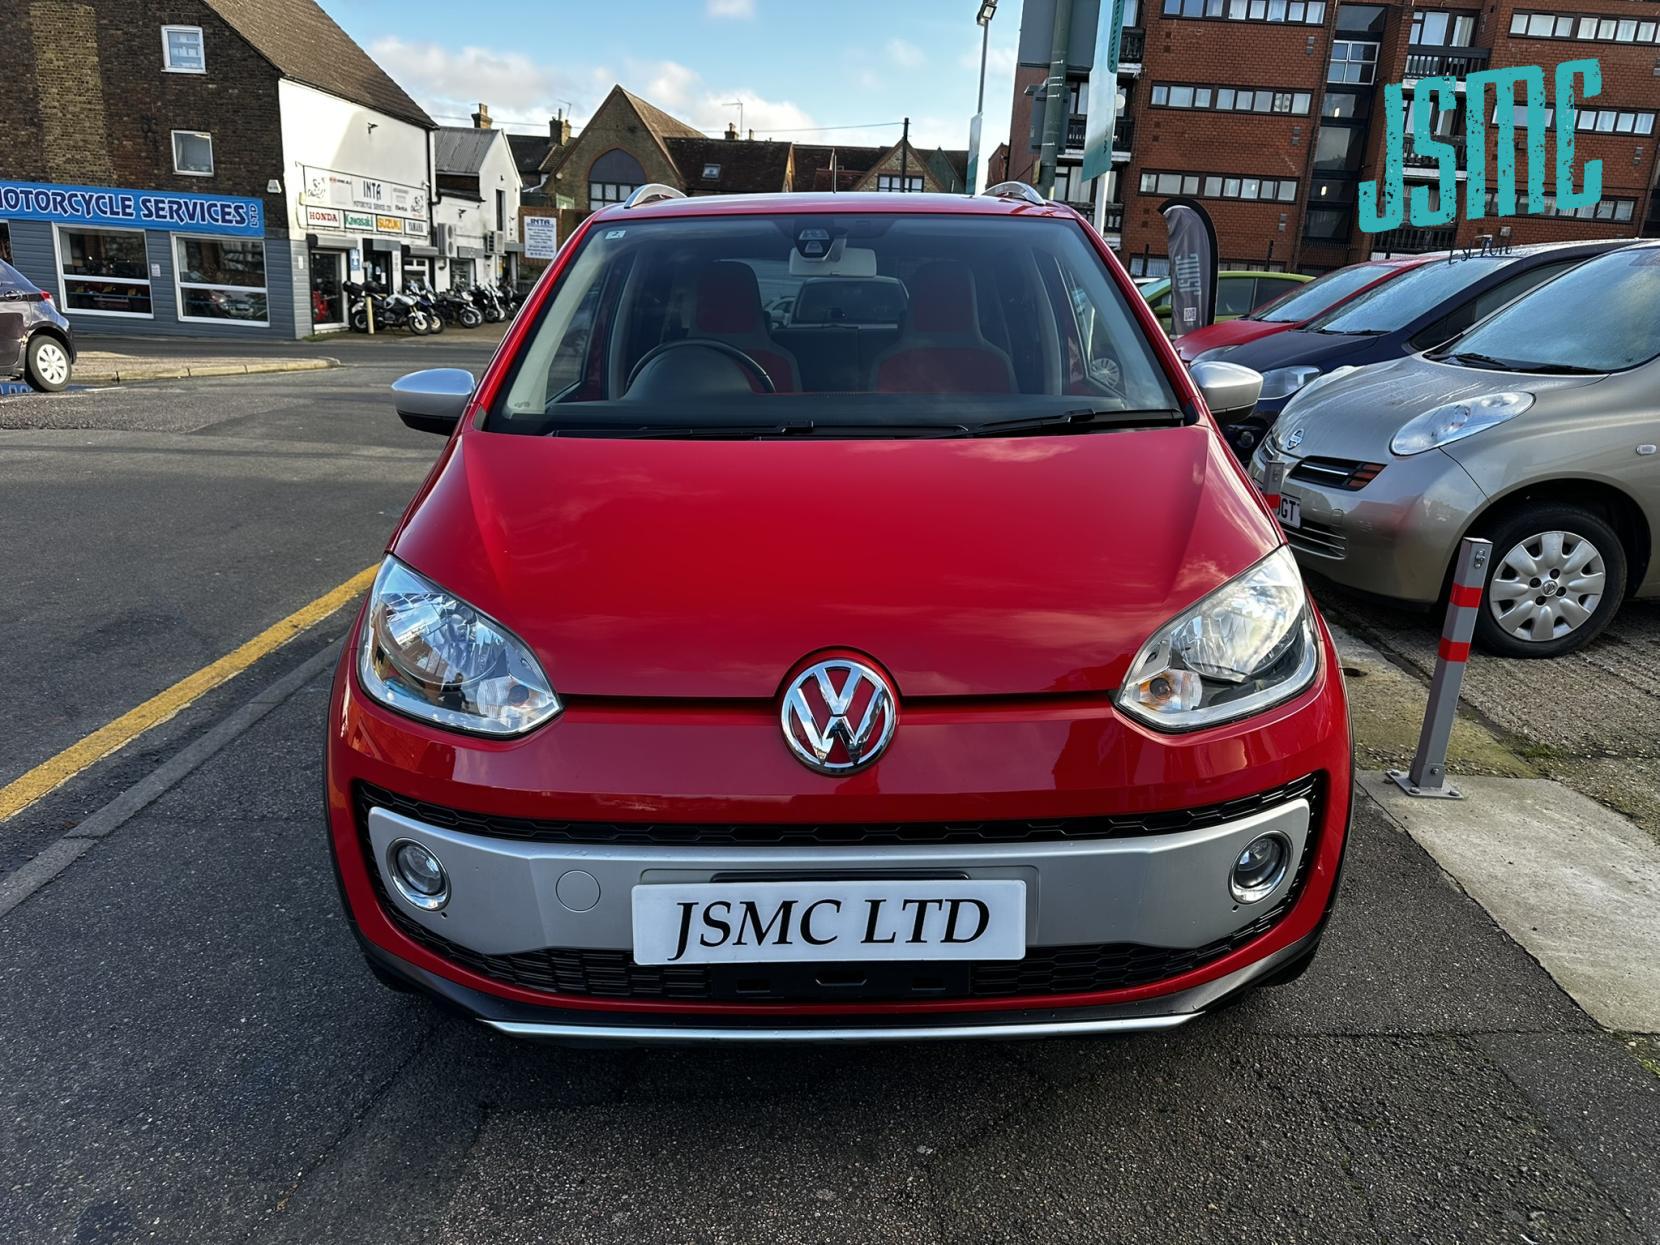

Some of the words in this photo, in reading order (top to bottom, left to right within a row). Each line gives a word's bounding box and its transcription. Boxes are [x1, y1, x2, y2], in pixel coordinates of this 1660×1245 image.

[0, 187, 136, 218] OTORCYCLE
[140, 196, 248, 225] SERVICES
[249, 203, 259, 228] LTD
[309, 211, 338, 223] HONDA
[378, 216, 402, 231] SUZUKI
[1277, 498, 1297, 522] GT
[667, 897, 842, 962] JSMC
[860, 897, 991, 946] LTD
